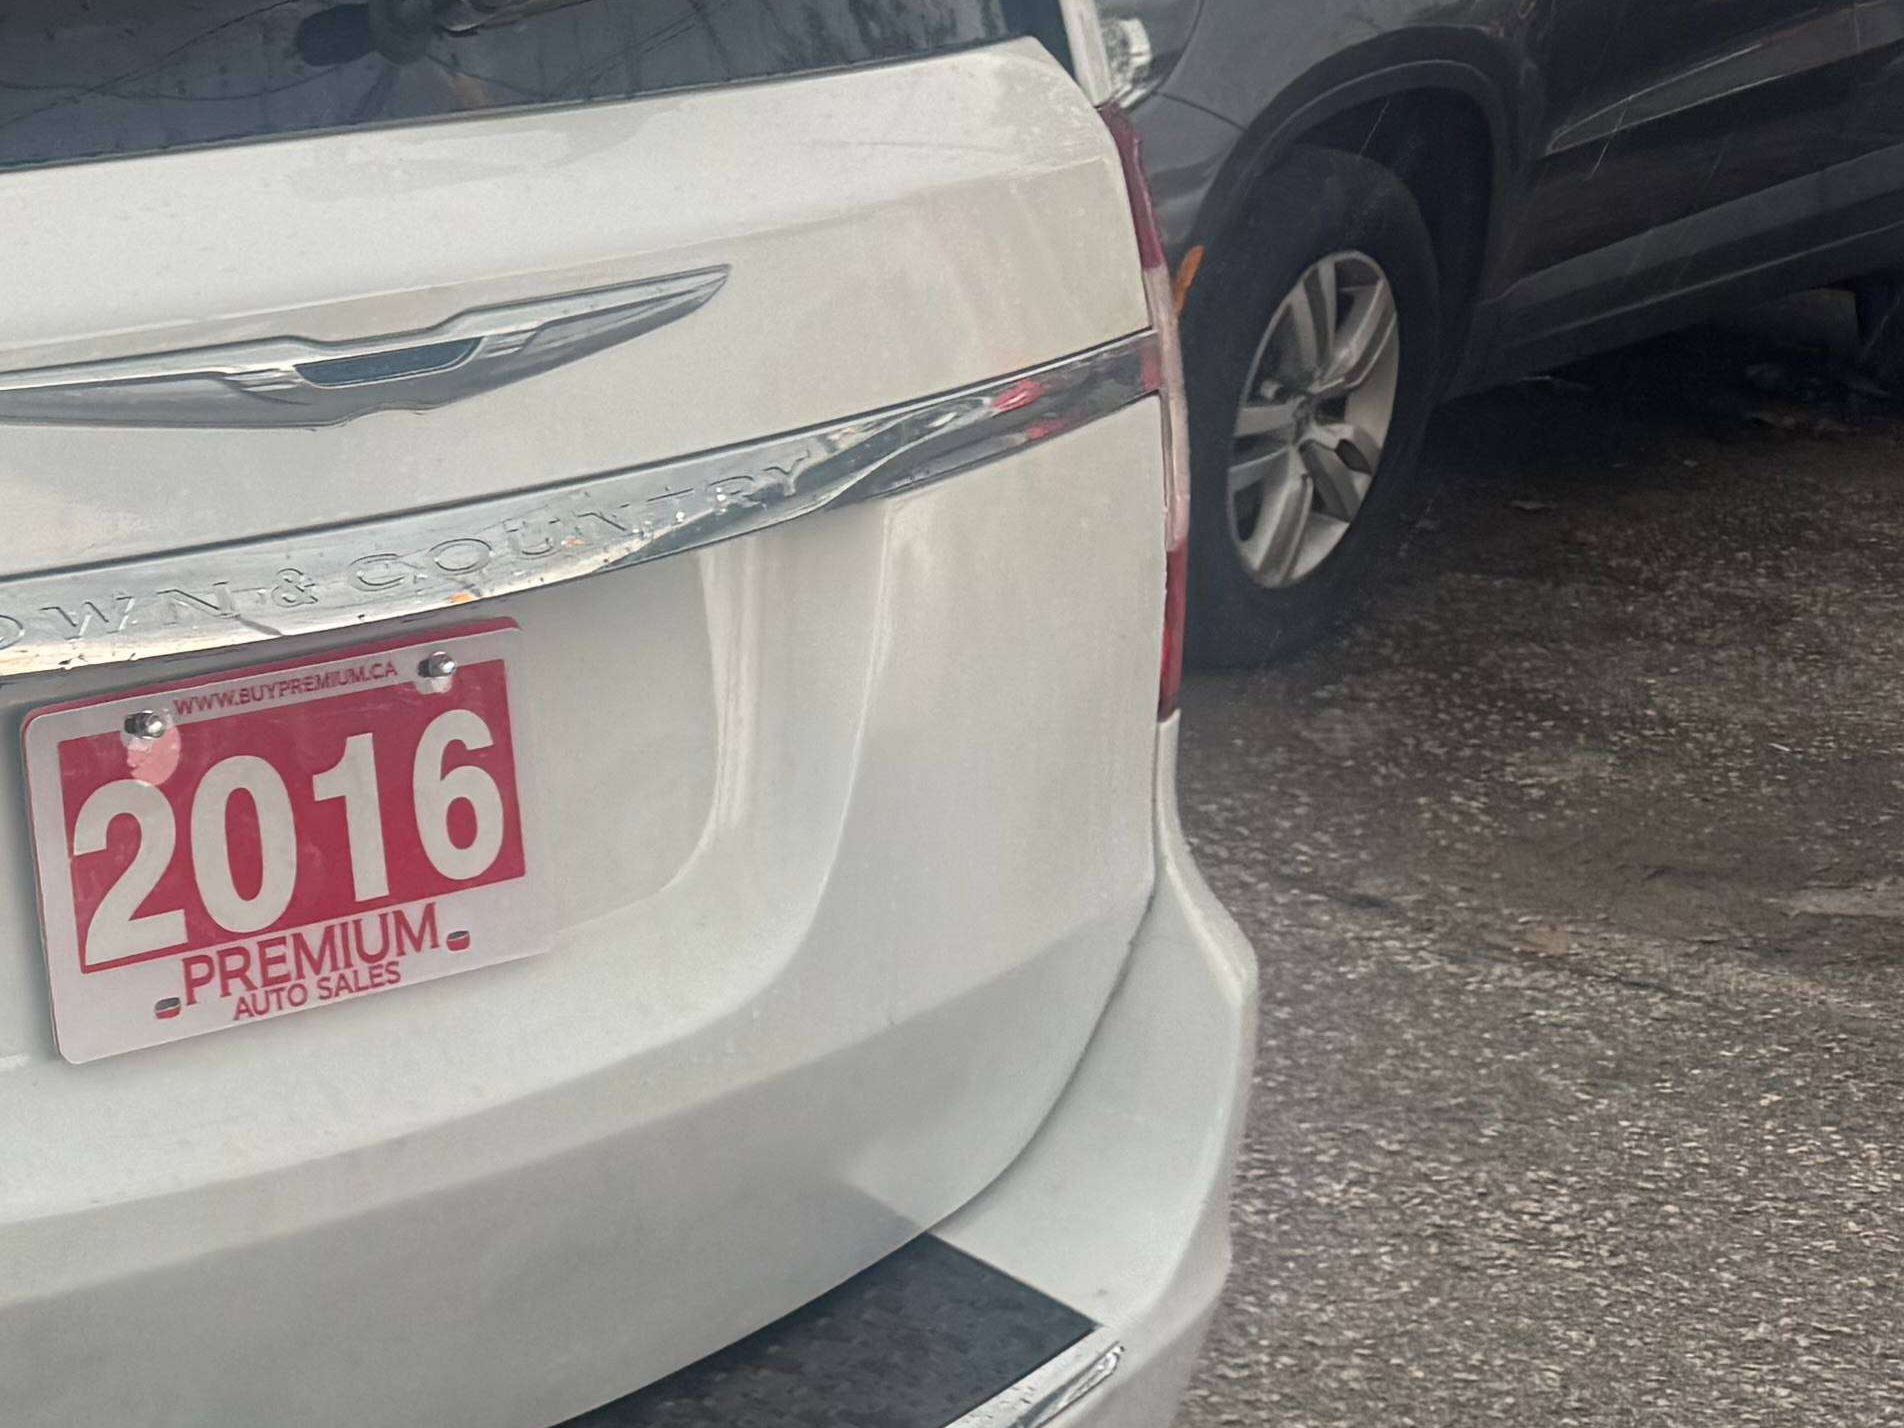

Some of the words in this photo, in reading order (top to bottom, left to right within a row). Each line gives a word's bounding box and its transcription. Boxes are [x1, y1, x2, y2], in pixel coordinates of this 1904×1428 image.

[270, 568, 318, 609] &
[173, 660, 398, 715] WWW.BUYPREMIUM.CA
[72, 708, 505, 967] 2016
[181, 901, 440, 1007] PREMIUM
[233, 981, 309, 1021] AUTO
[317, 960, 402, 1002] SALES
